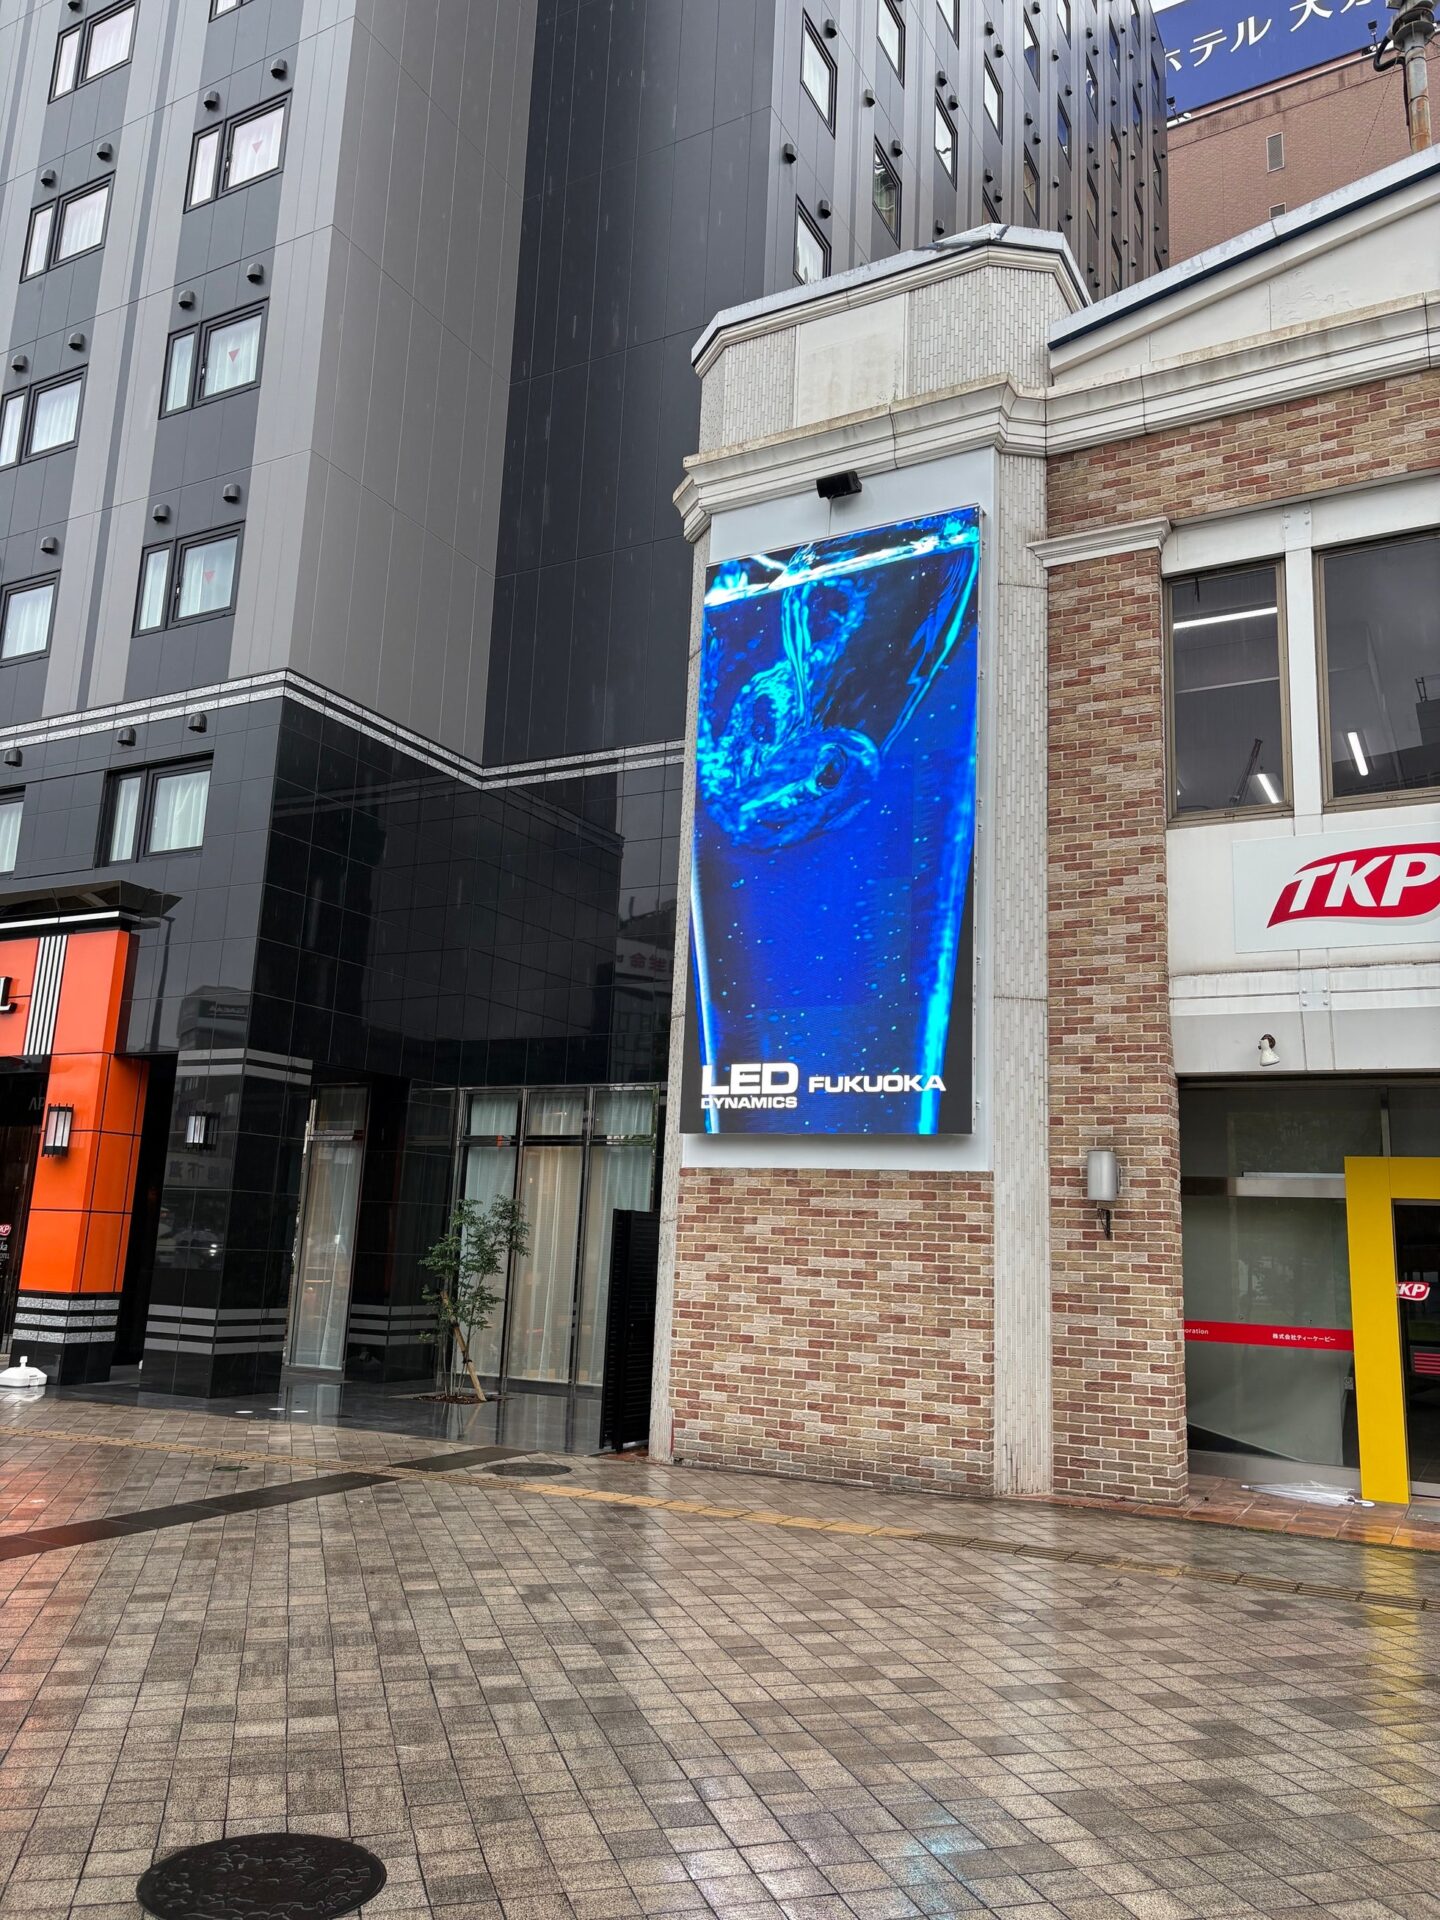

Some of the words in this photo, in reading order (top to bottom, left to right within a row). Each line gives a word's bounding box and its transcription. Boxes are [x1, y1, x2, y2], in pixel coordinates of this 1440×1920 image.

[1286, 852, 1440, 913] TKP
[701, 1062, 799, 1096] LED
[808, 1074, 947, 1094] FUKUOKA
[700, 1096, 798, 1110] DYNAMICS
[1184, 1327, 1209, 1335] oration
